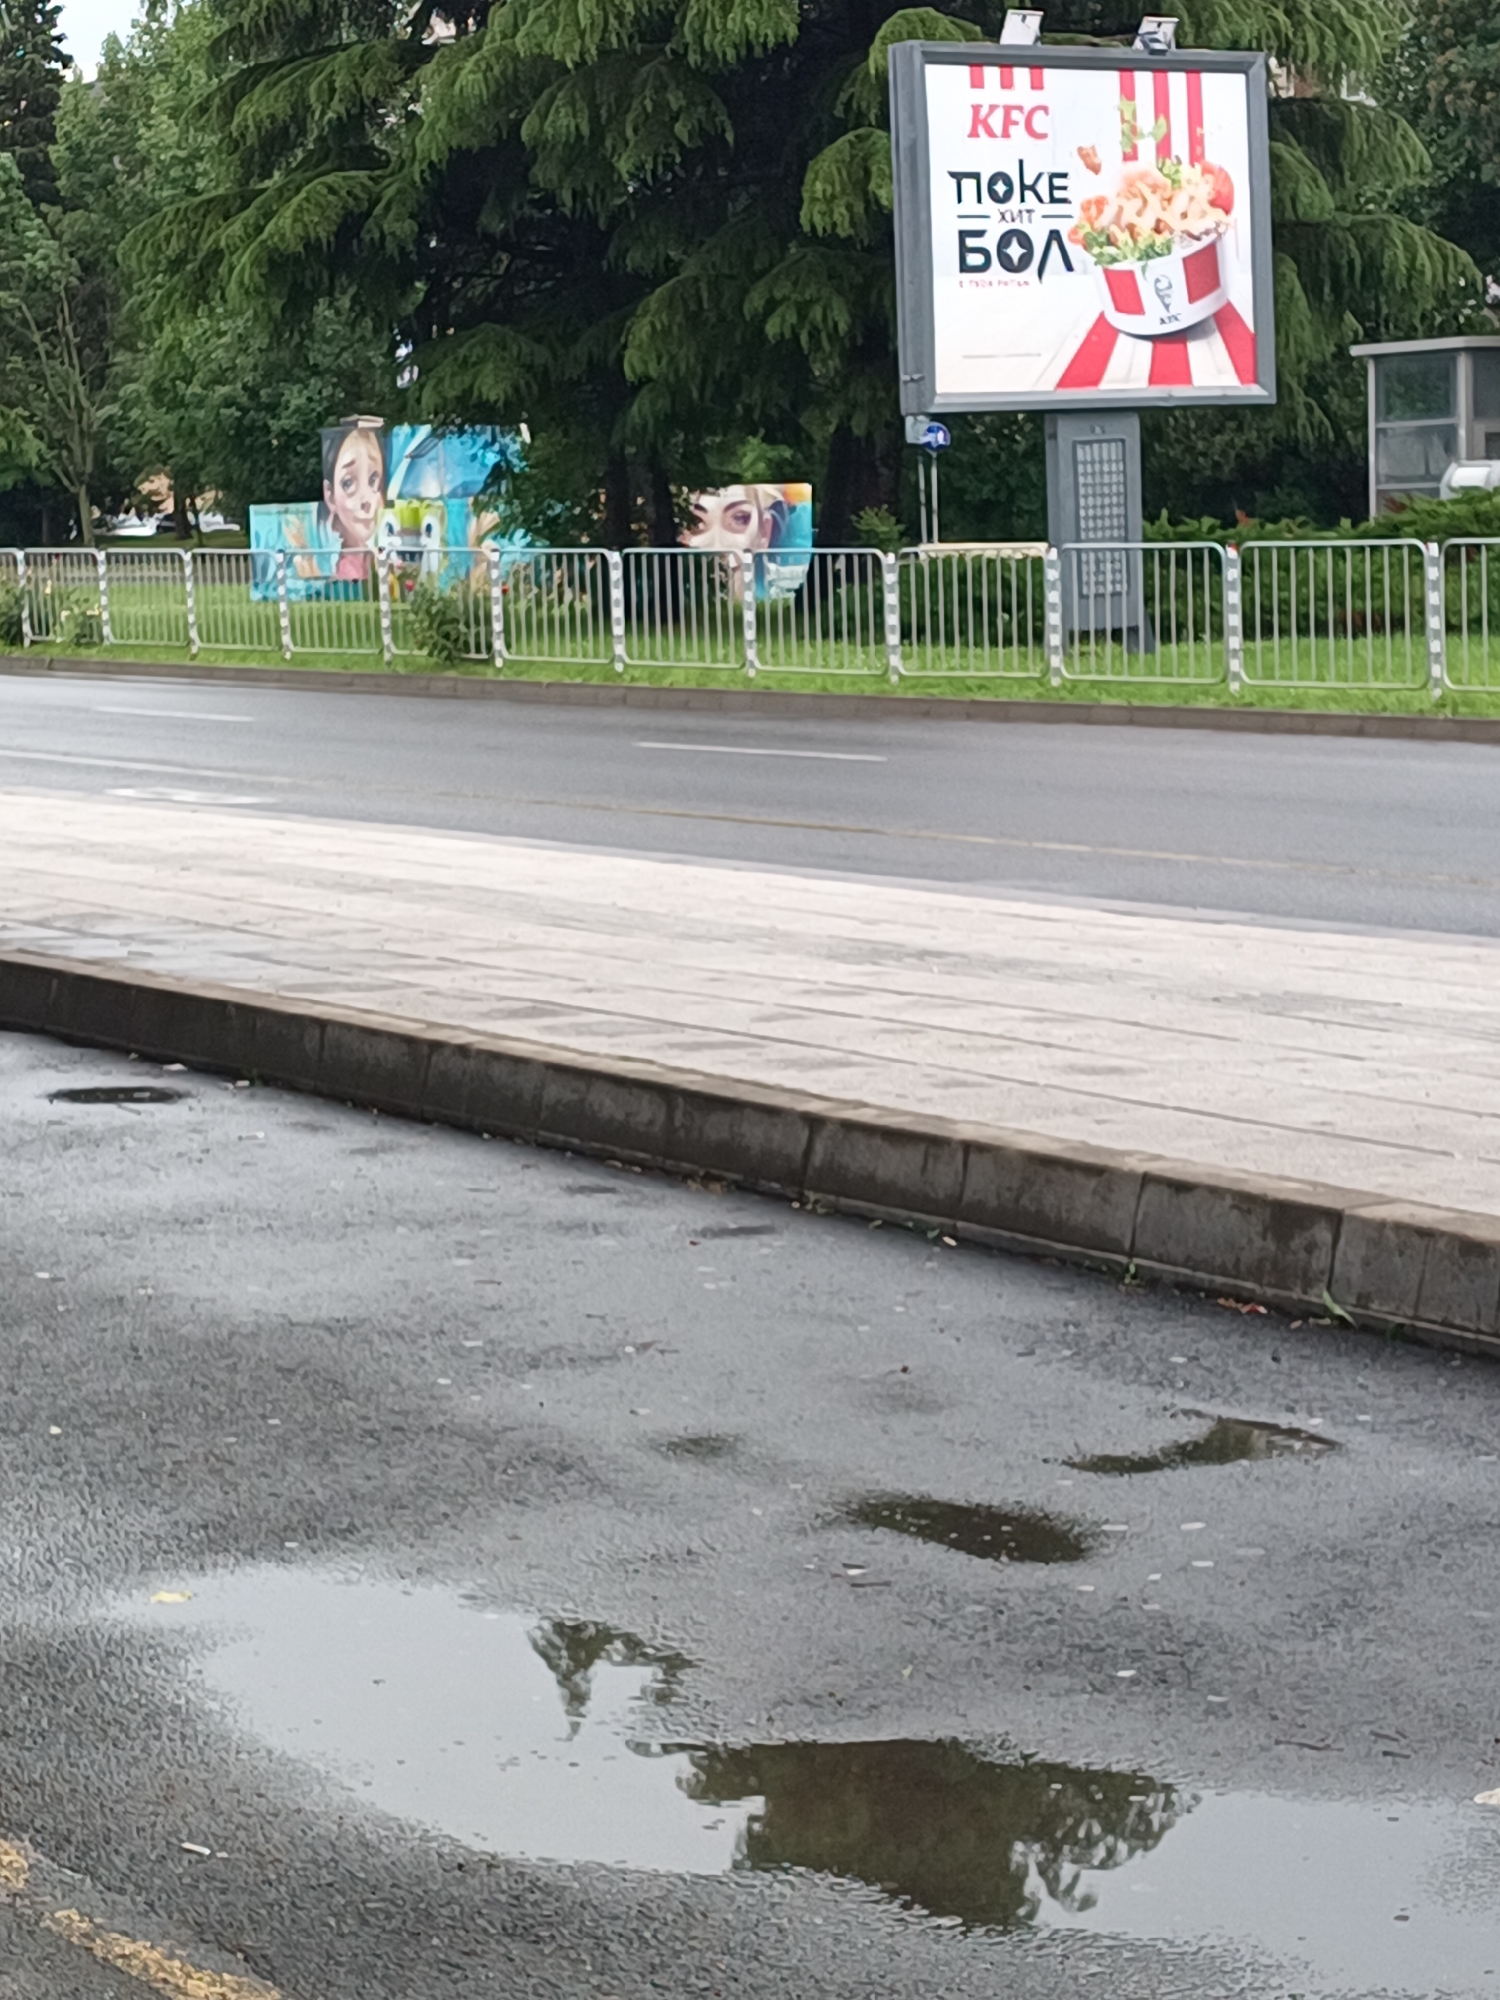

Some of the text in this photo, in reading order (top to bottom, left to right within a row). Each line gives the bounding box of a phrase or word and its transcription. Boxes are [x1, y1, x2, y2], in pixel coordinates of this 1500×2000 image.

[967, 104, 1049, 140] KFC
[997, 208, 1036, 224] ХИТ
[957, 228, 1075, 284] БОЛ
